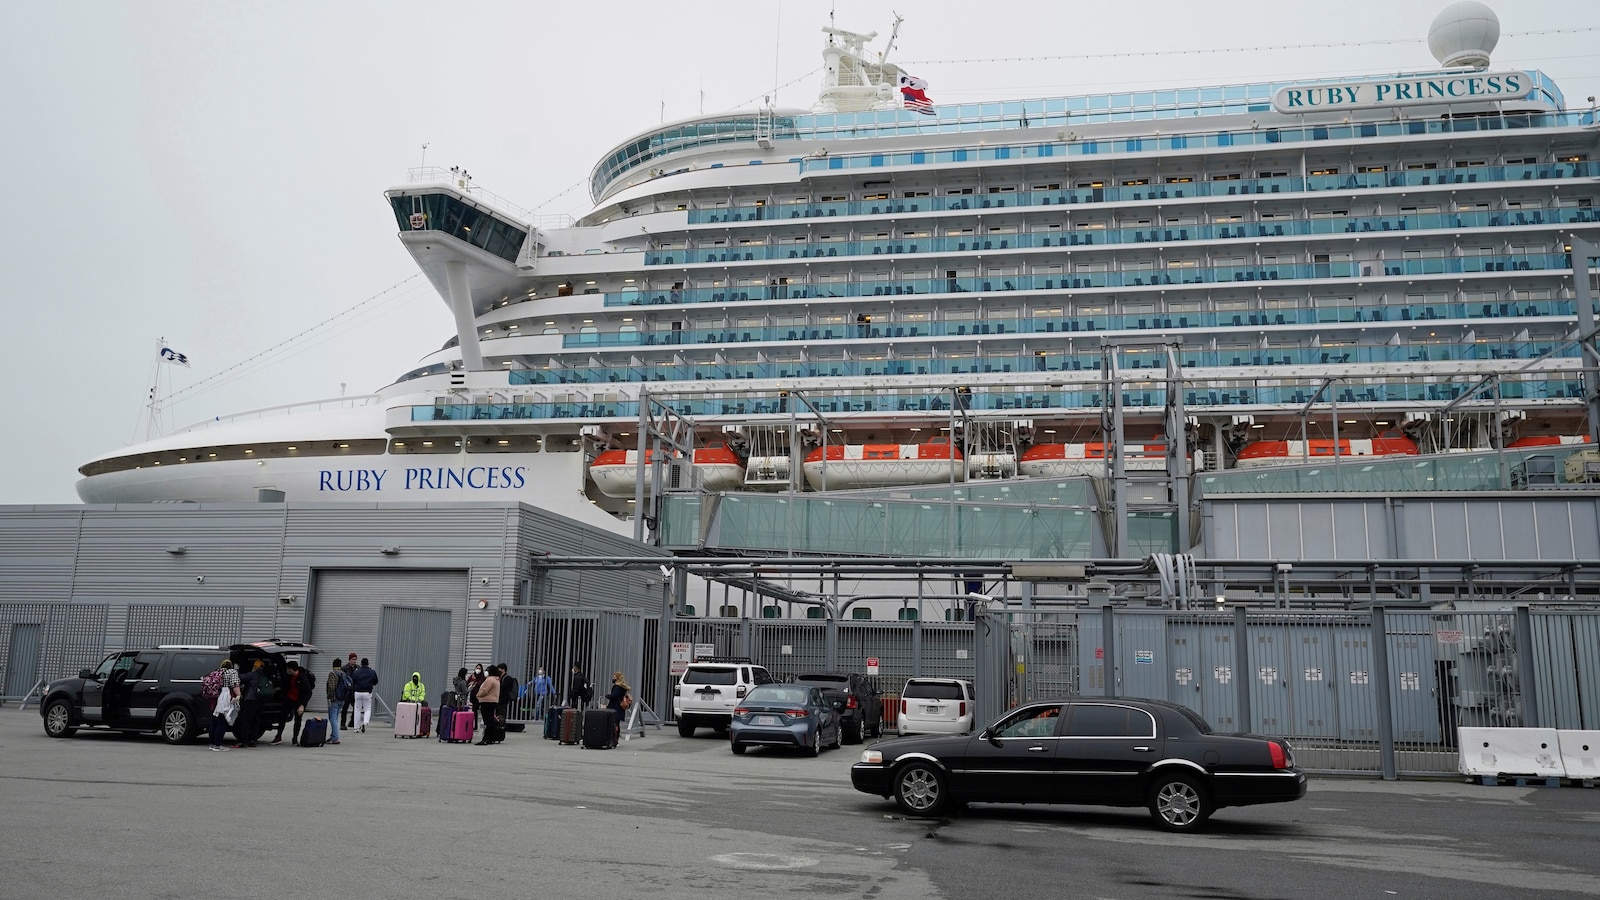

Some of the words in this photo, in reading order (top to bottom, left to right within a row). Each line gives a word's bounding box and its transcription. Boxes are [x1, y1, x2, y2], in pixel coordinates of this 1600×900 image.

[1287, 85, 1361, 107] RUBY
[1376, 75, 1521, 102] PRINCESS
[318, 469, 388, 491] RUBY
[404, 466, 526, 490] PRINCESS
